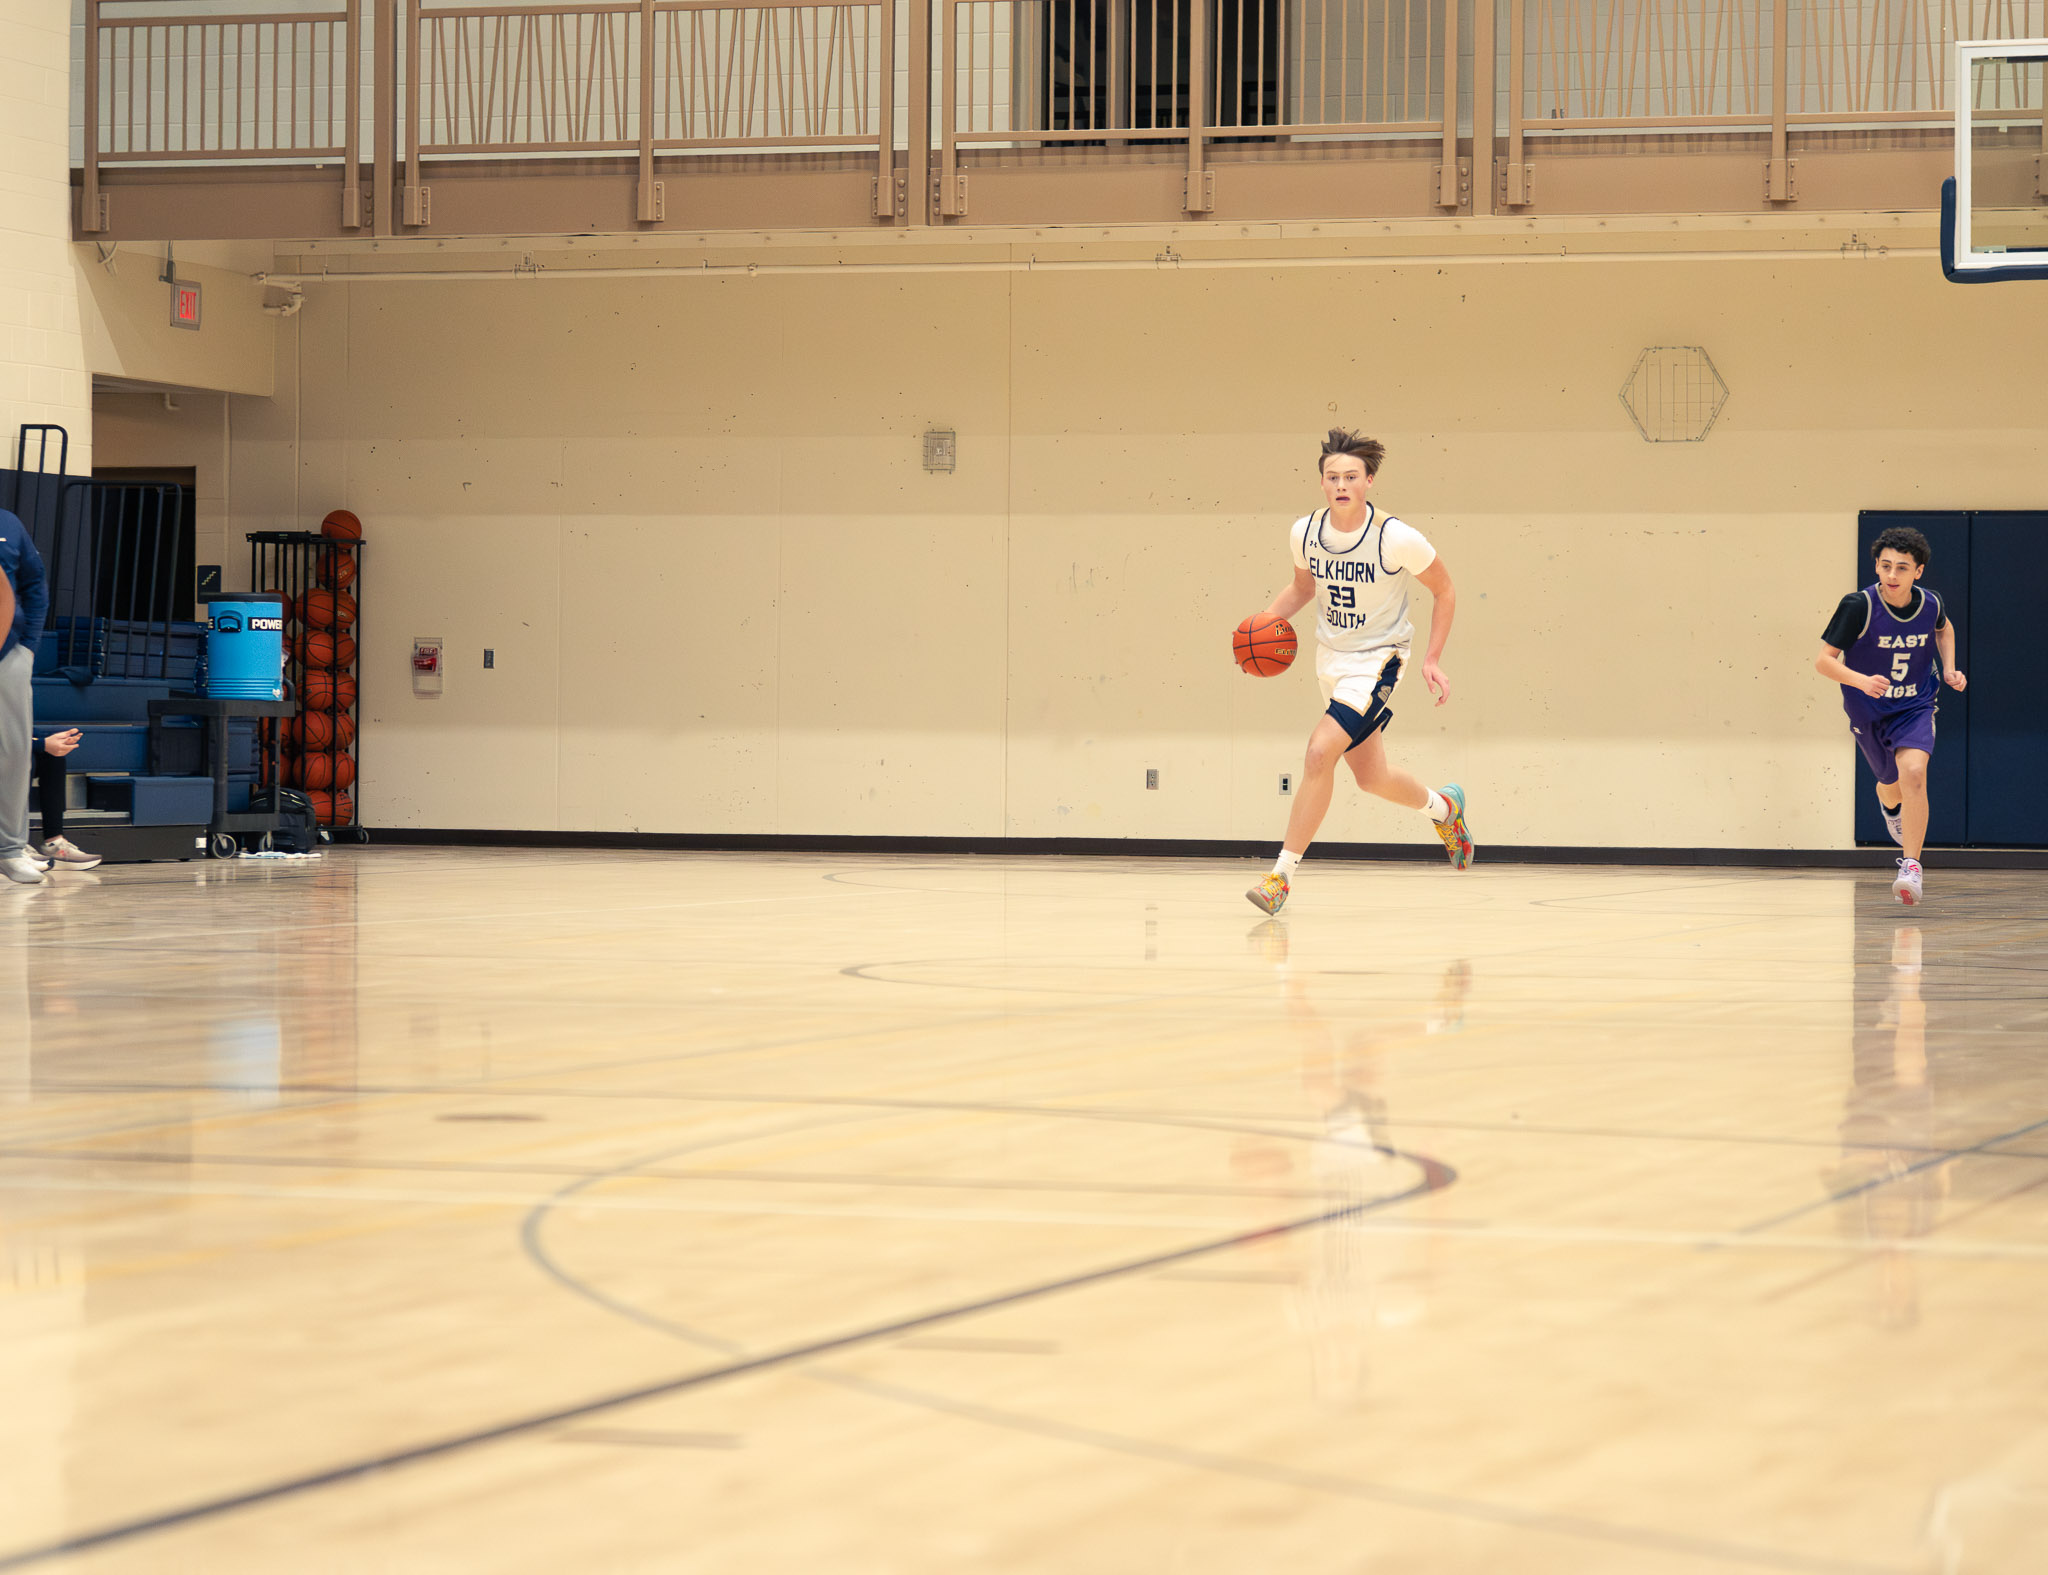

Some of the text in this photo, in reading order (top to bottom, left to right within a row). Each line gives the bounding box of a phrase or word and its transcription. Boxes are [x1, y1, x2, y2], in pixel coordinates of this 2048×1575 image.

[180, 290, 196, 320] EXIT
[1310, 557, 1375, 583] ELKHORN
[1327, 585, 1356, 608] 23
[252, 619, 283, 630] POWE
[1326, 606, 1366, 629] SOUTH
[1878, 634, 1928, 648] EAST
[1891, 653, 1911, 682] 5
[1884, 683, 1918, 698] IGH
